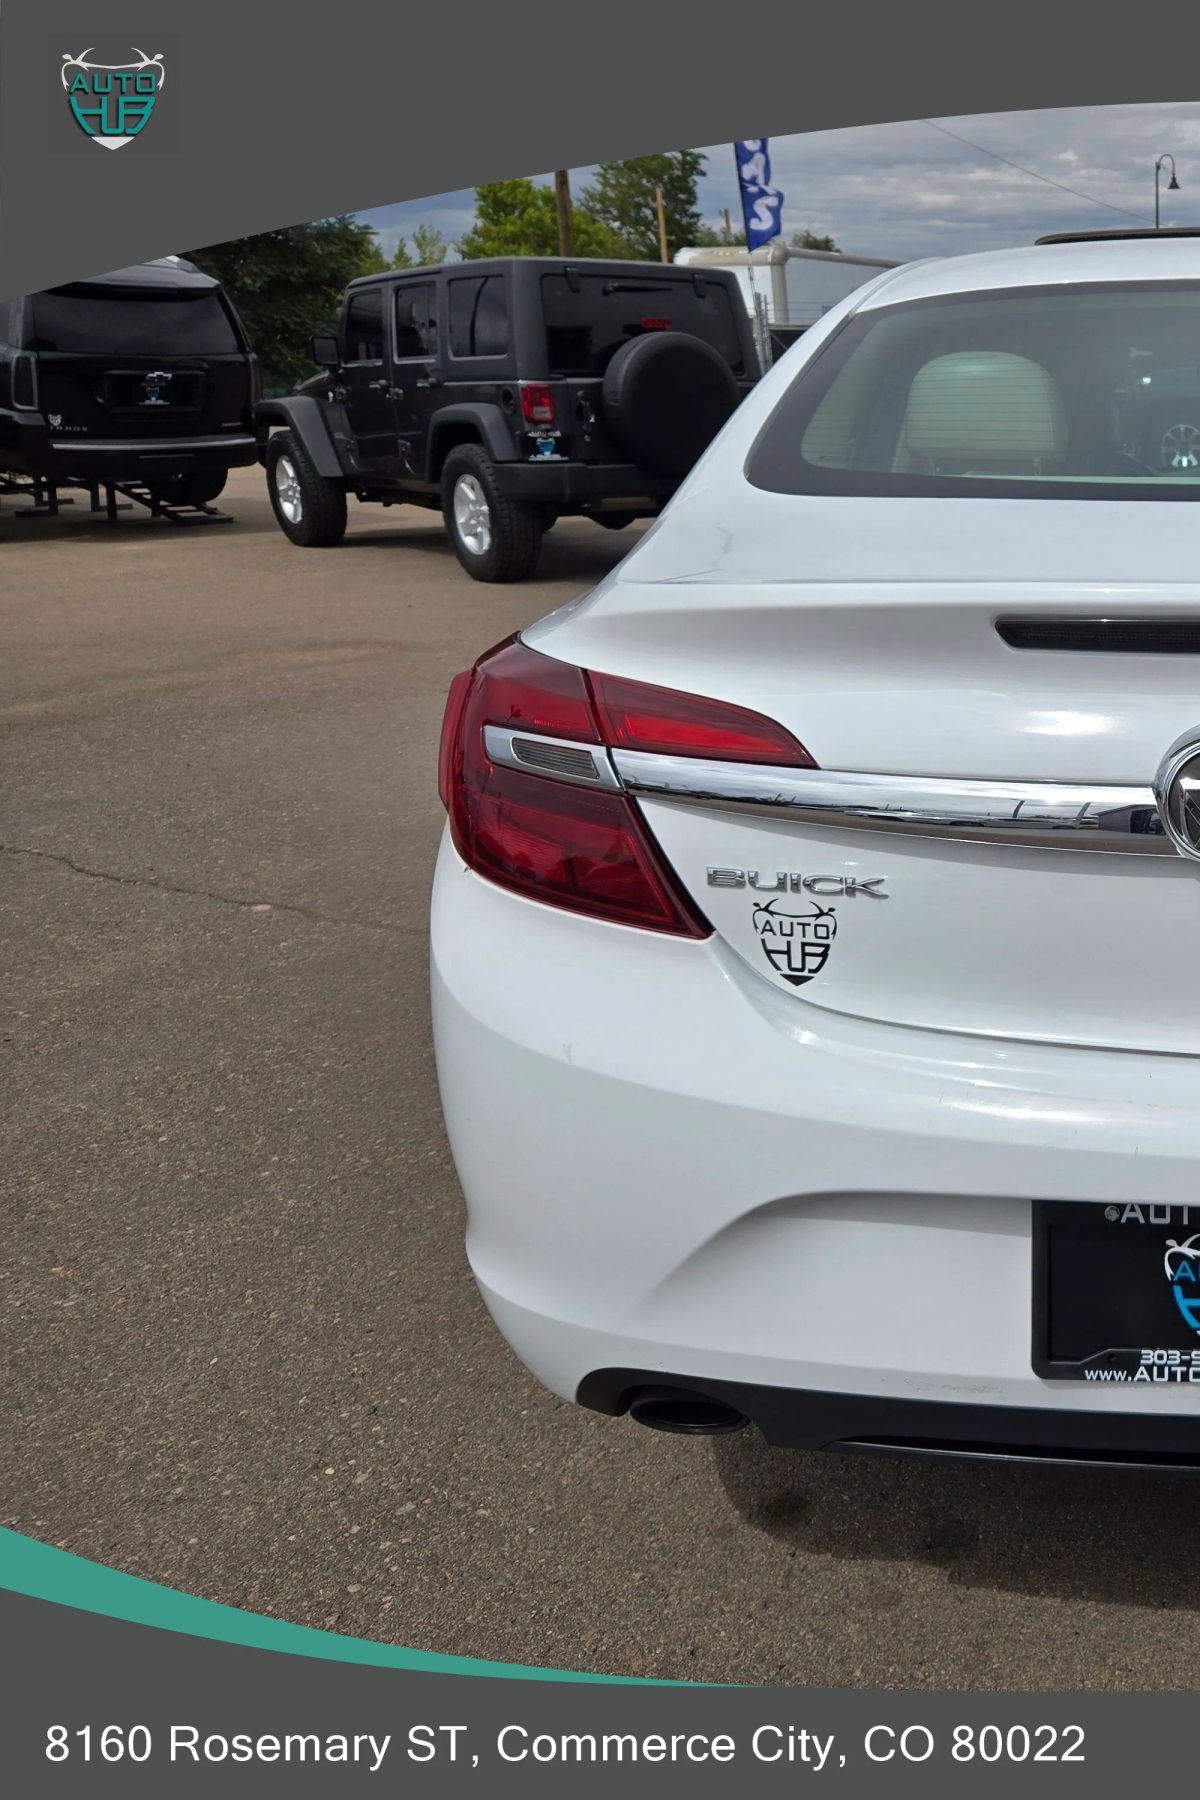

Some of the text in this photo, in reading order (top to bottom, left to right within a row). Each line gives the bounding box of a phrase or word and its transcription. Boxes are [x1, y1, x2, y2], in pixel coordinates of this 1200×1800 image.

[706, 867, 890, 899] BUICK
[760, 919, 830, 940] AUTO
[761, 938, 831, 974] HUB
